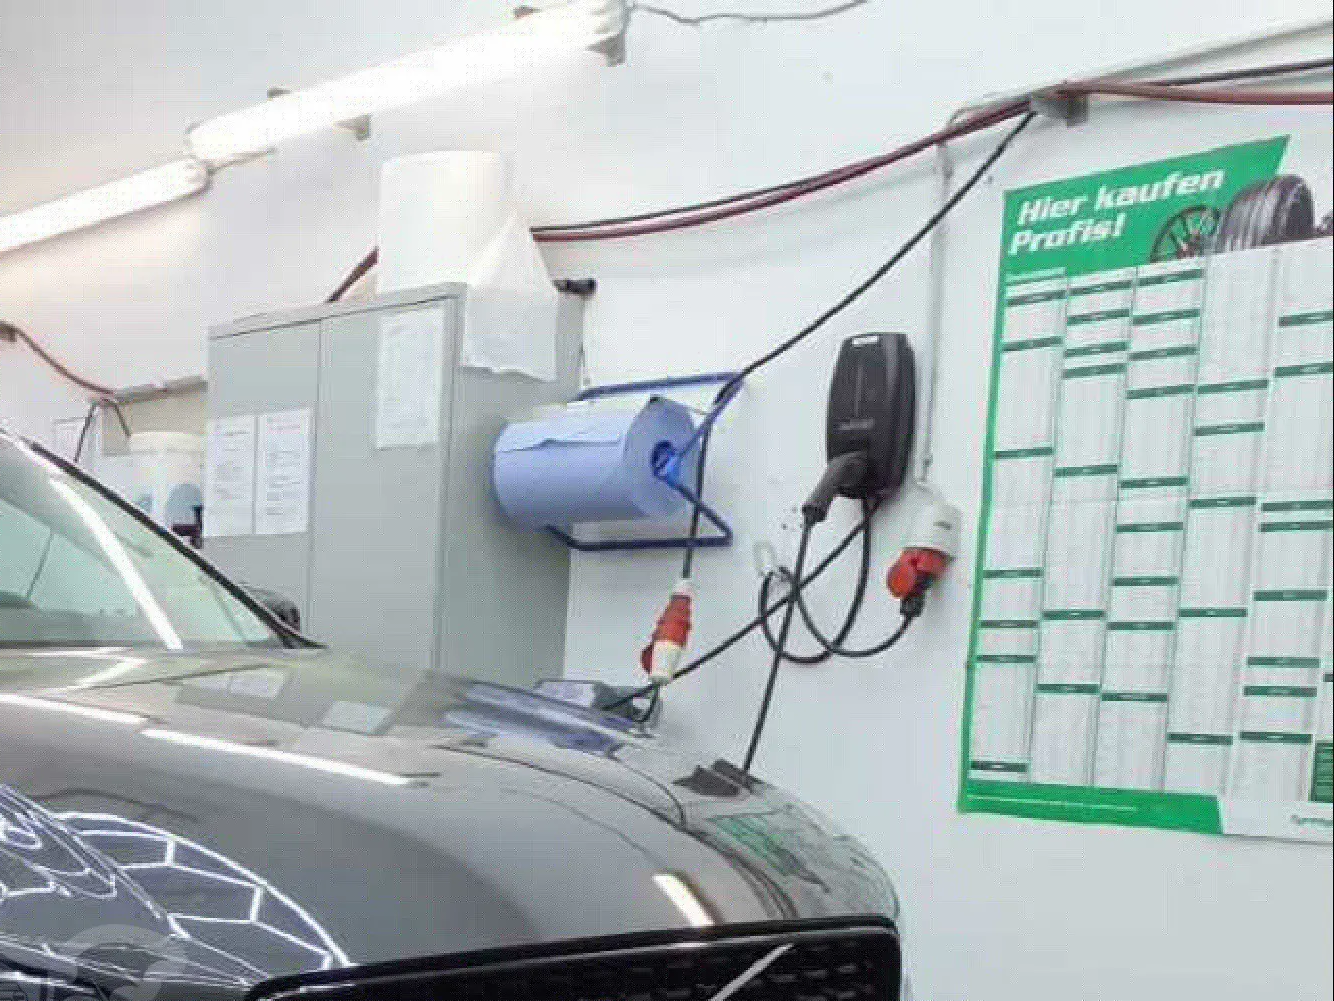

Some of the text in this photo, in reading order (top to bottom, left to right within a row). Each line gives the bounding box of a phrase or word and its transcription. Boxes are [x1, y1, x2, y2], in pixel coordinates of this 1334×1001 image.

[1017, 169, 1226, 226] Hier kaufen
[1008, 211, 1127, 256] Profis!
